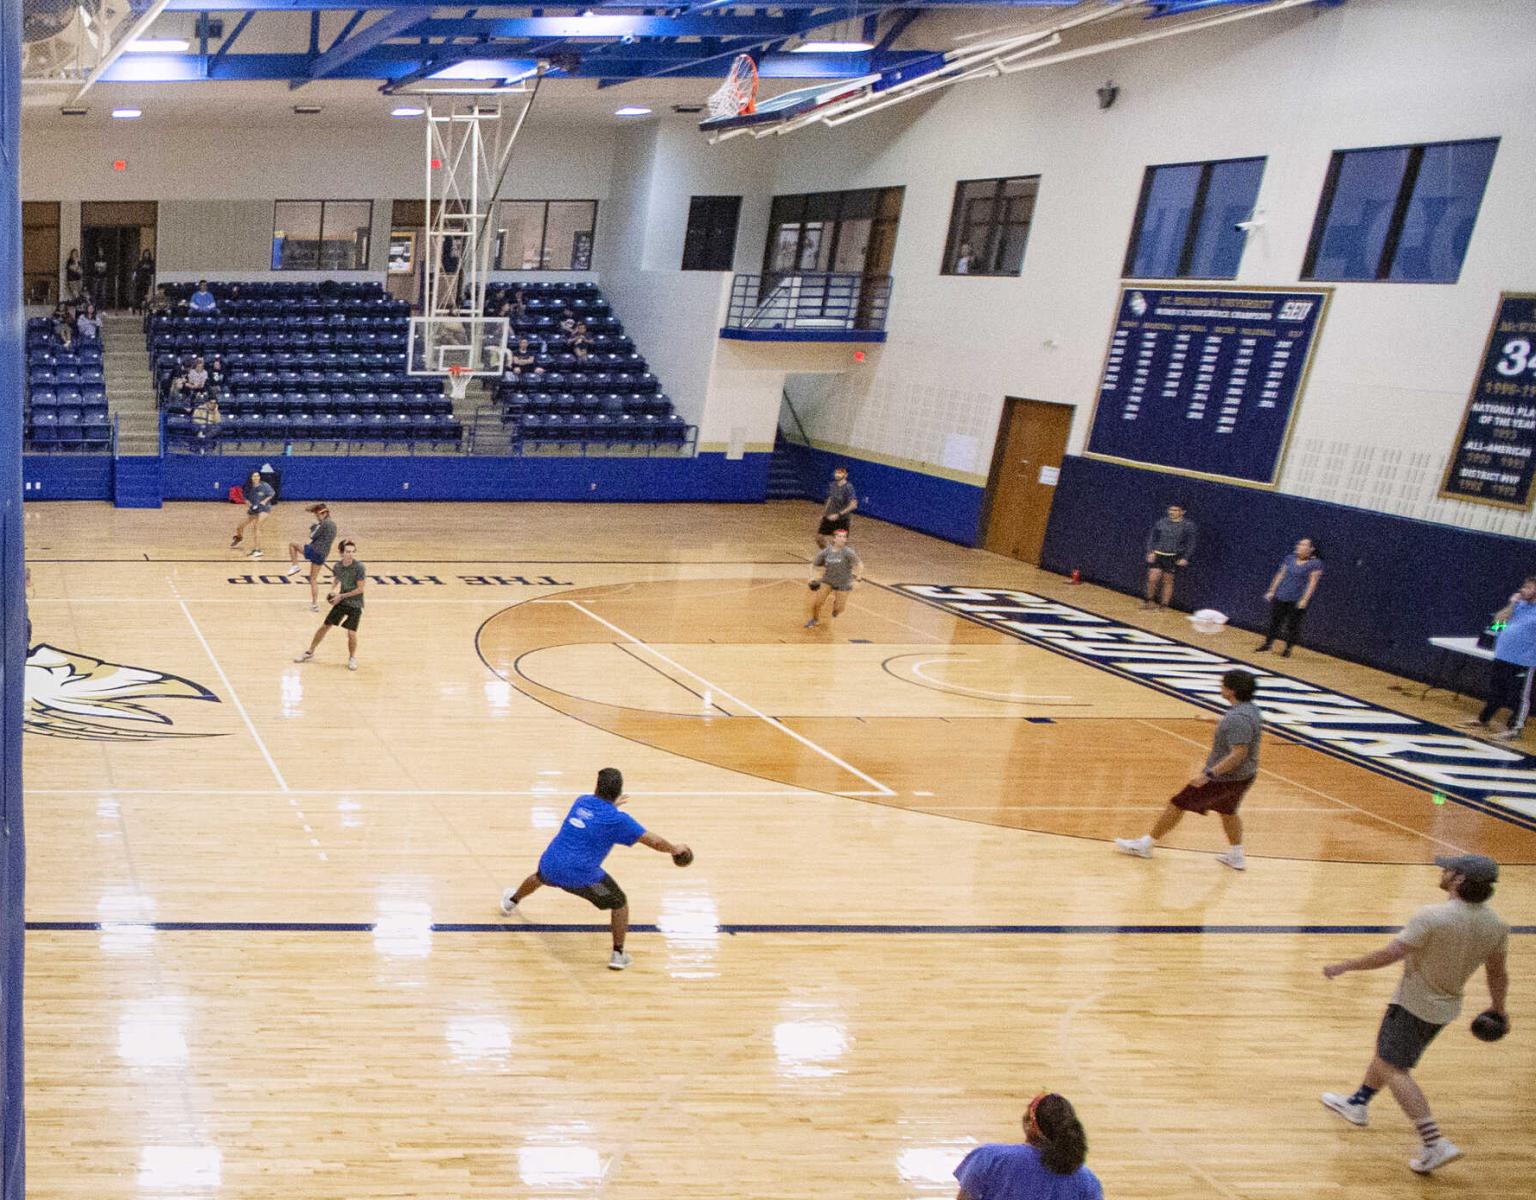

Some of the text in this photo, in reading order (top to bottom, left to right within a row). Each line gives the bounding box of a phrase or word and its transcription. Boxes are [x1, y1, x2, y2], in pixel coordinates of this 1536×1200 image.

[1278, 301, 1314, 321] SEU
[1496, 340, 1536, 377] 3
[1472, 402, 1516, 416] NATIONAL
[1478, 416, 1493, 426] OF
[1495, 417, 1513, 428] THE
[1465, 440, 1533, 457] ALL-AMERICAN
[1460, 468, 1521, 485] DISTRICT MVP
[227, 575, 574, 586] THE HILTOP
[998, 622, 1536, 818] EDWARD
